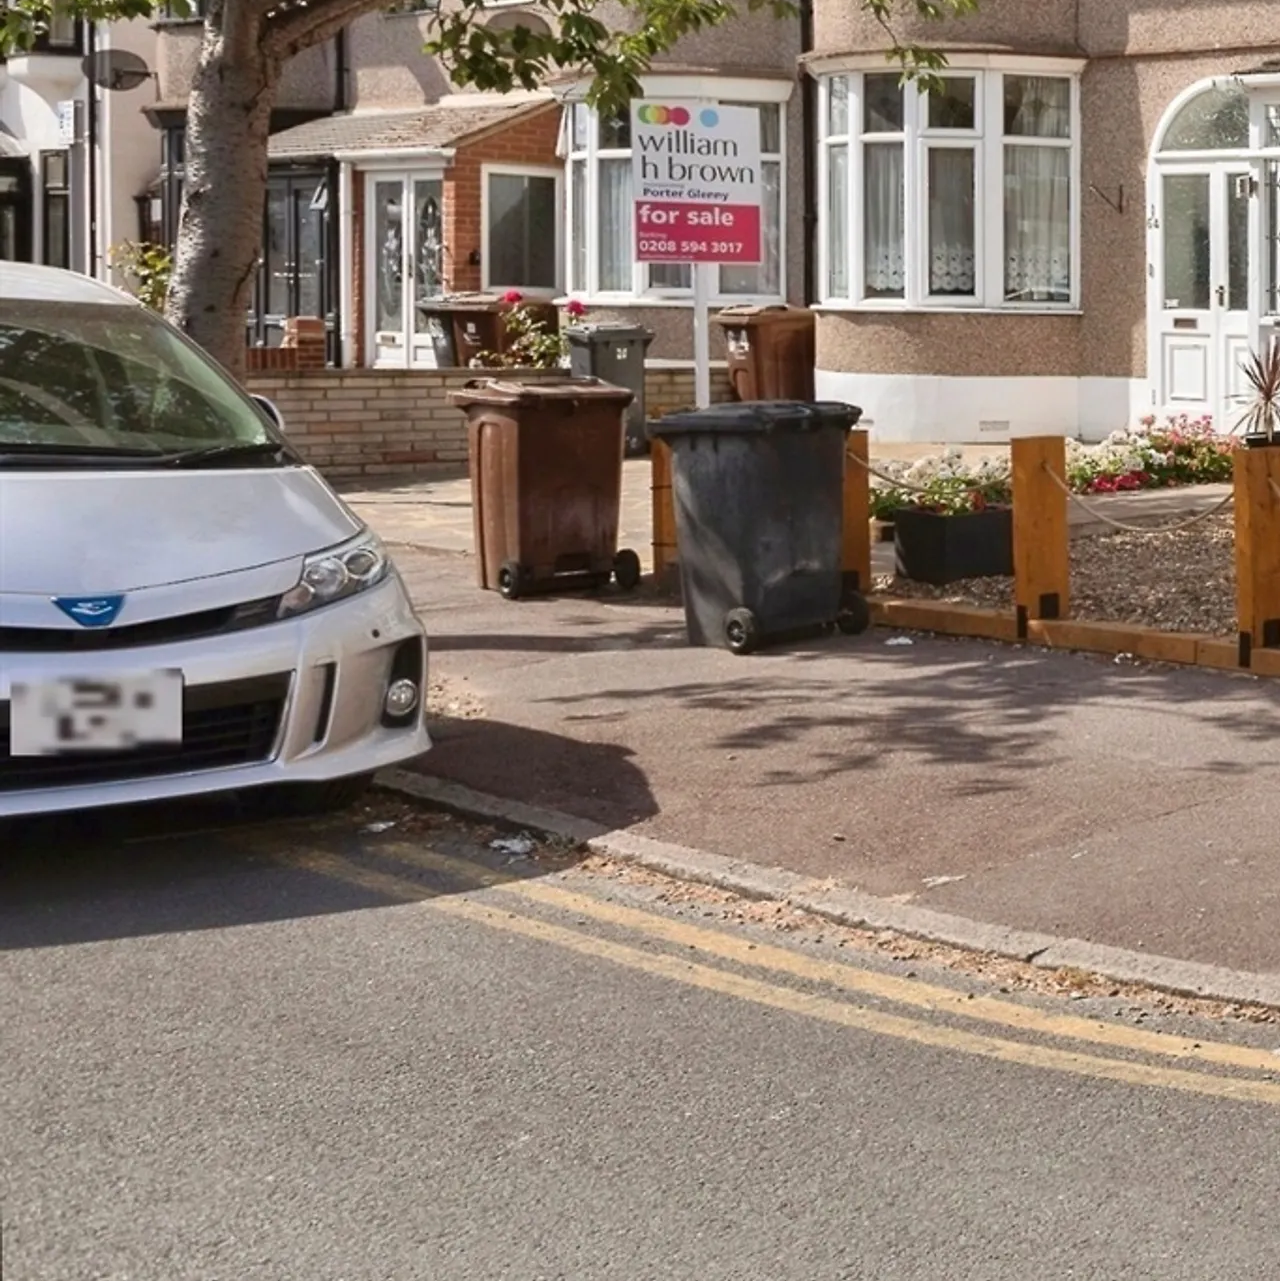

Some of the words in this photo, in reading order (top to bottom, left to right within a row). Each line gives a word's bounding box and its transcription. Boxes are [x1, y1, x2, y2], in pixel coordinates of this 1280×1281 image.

[638, 130, 738, 157] william
[642, 155, 658, 179] h
[668, 156, 754, 183] brown
[643, 188, 683, 198] Porter
[639, 205, 679, 224] for
[687, 207, 733, 225] sale
[639, 240, 677, 252] 0208
[681, 241, 708, 253] 594
